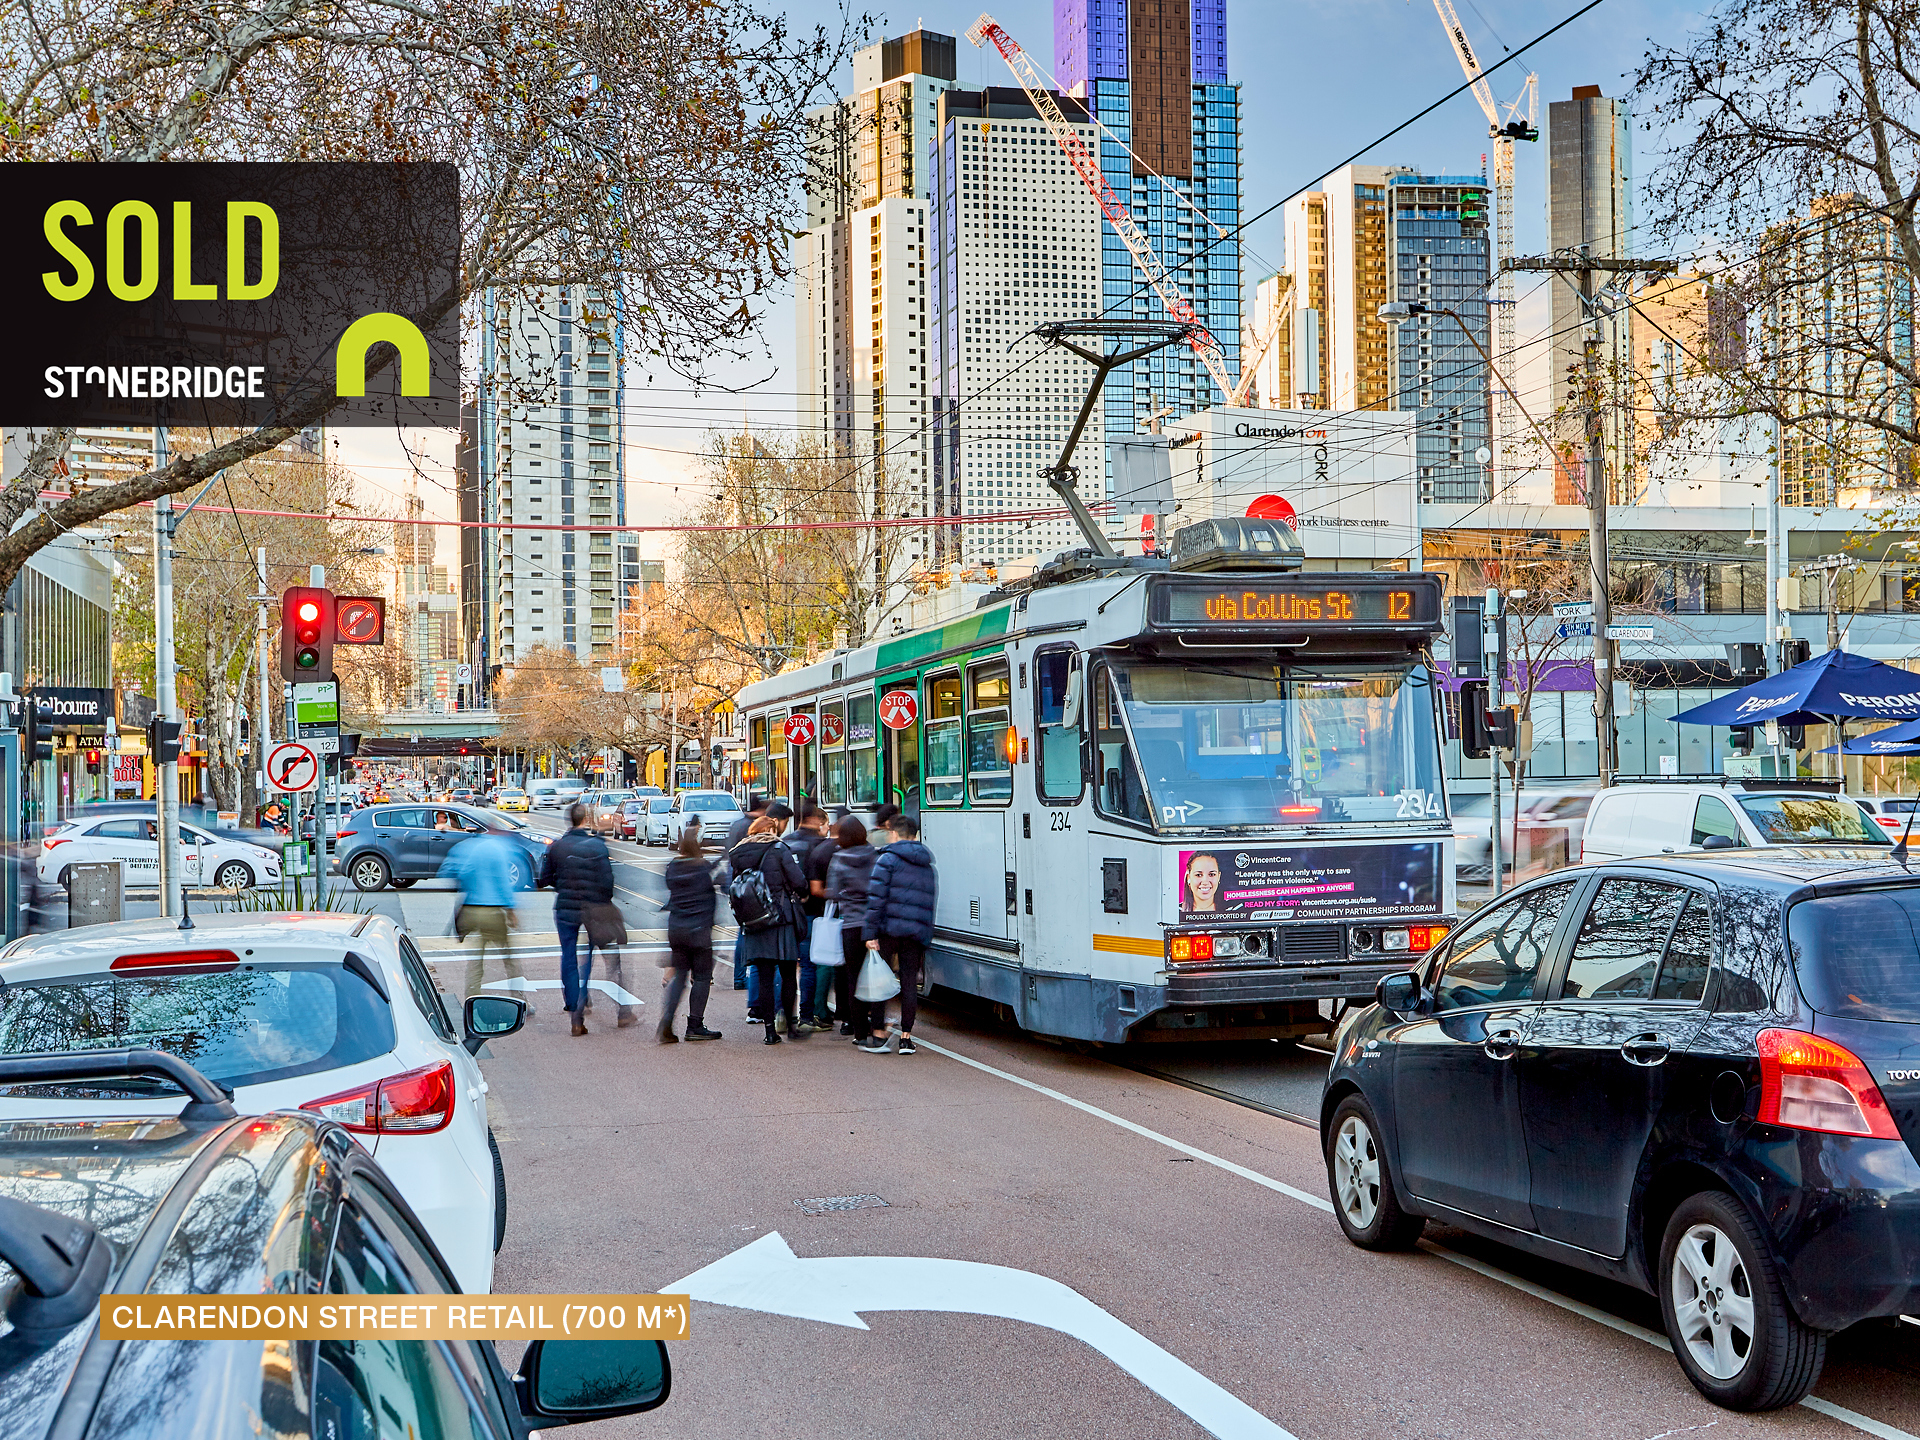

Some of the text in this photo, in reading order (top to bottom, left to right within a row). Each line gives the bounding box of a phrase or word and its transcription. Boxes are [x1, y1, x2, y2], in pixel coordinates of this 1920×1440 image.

[1461, 43, 1475, 68] GROUP
[1306, 429, 1327, 438] on
[1314, 440, 1328, 481] YORK
[1321, 517, 1358, 526] business
[1361, 519, 1389, 527] centre
[1206, 592, 1410, 619] via Collins St 12
[1557, 606, 1581, 616] YORK
[1565, 622, 1590, 631] STH MELB
[1611, 629, 1648, 638] CLARENDON
[885, 695, 911, 706] STOP
[788, 717, 811, 727] STOP
[79, 736, 103, 746] ATM
[321, 741, 336, 750] 127
[114, 768, 142, 782] OOLS
[1393, 793, 1441, 818] 234
[1050, 811, 1072, 832] 234
[1251, 856, 1291, 864] VincentCare
[1295, 868, 1310, 877] only
[1250, 878, 1265, 886] kids
[1267, 877, 1283, 885] from
[1226, 890, 1275, 898] HOMELESSNESS
[1276, 899, 1300, 907] STORY:
[1297, 908, 1344, 917] COMMUNITY
[1345, 906, 1399, 915] PARTNERSHIPS
[1400, 904, 1436, 913] PROGRAM
